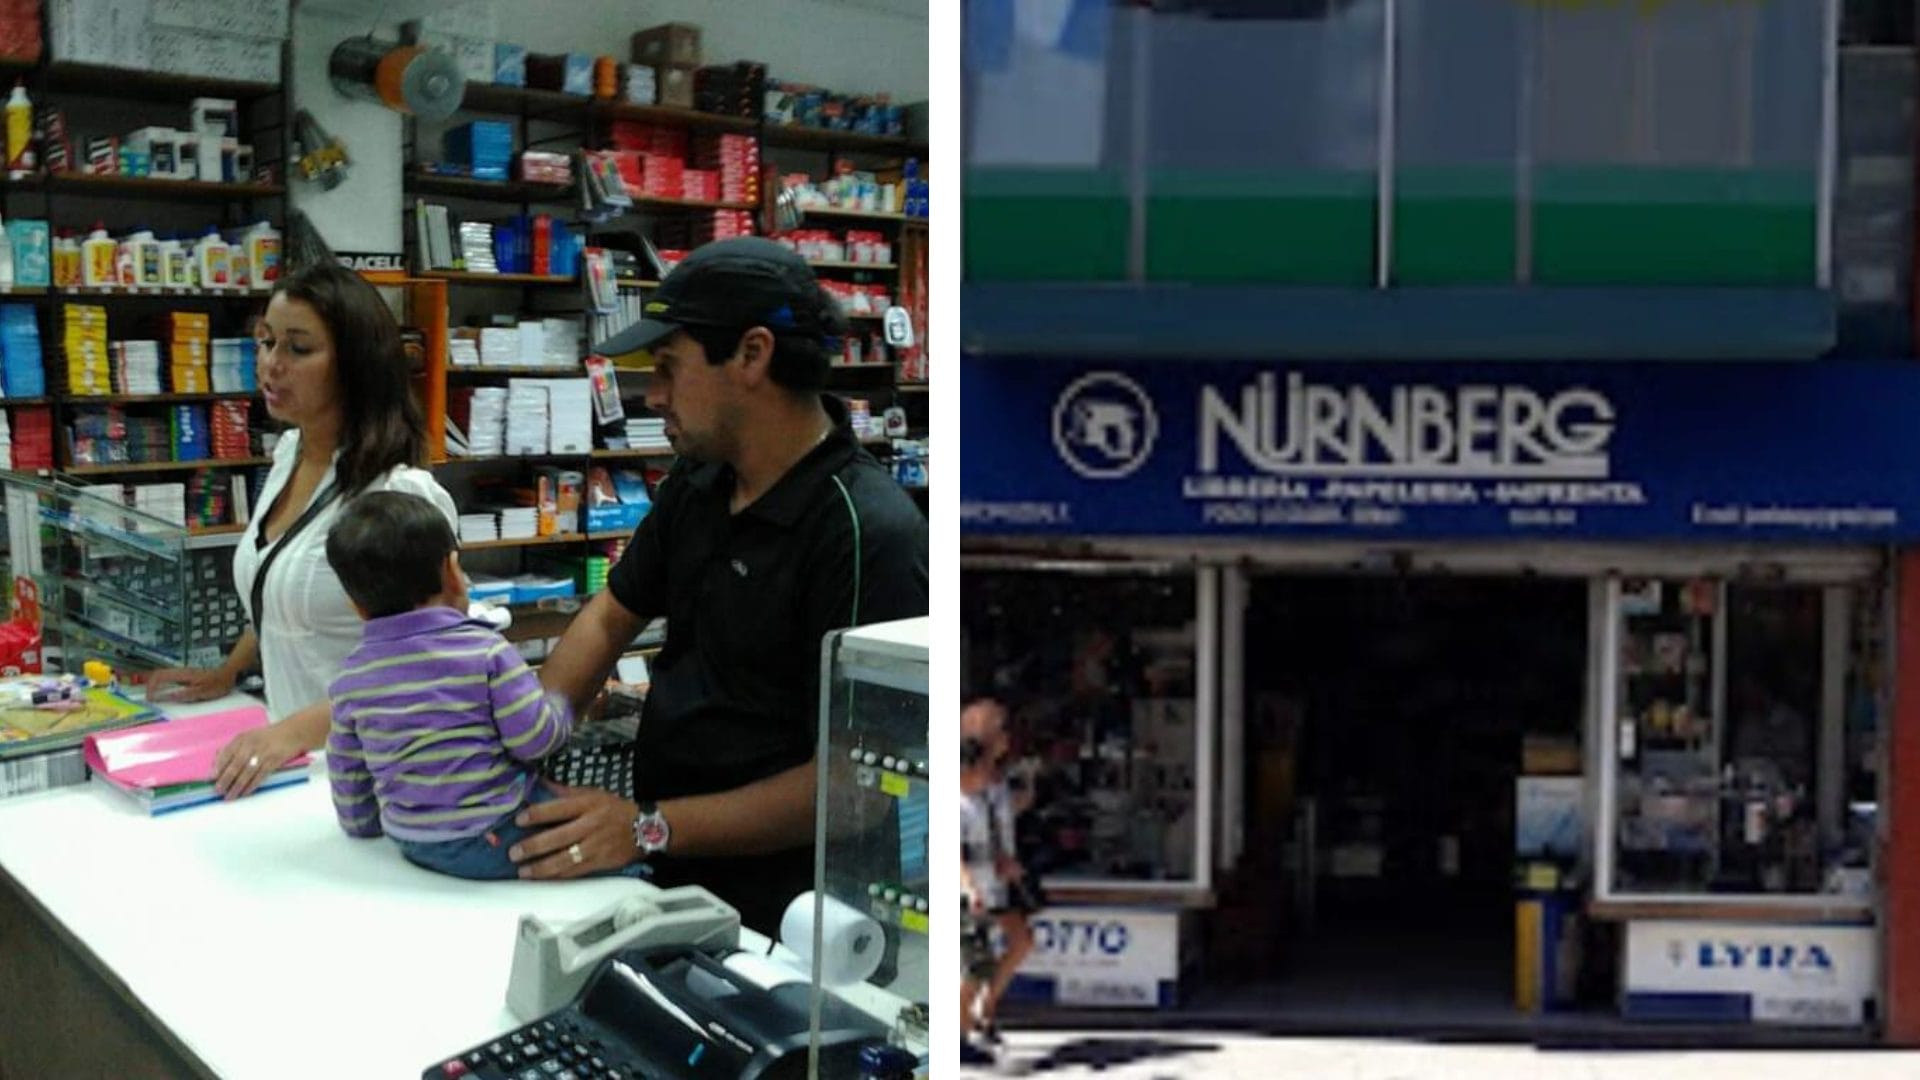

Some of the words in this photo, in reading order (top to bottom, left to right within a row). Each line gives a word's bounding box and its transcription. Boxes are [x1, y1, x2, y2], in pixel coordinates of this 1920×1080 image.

[335, 255, 405, 271] RACELL
[1031, 919, 1129, 956] OTTO
[1697, 942, 1834, 968] LYRA
